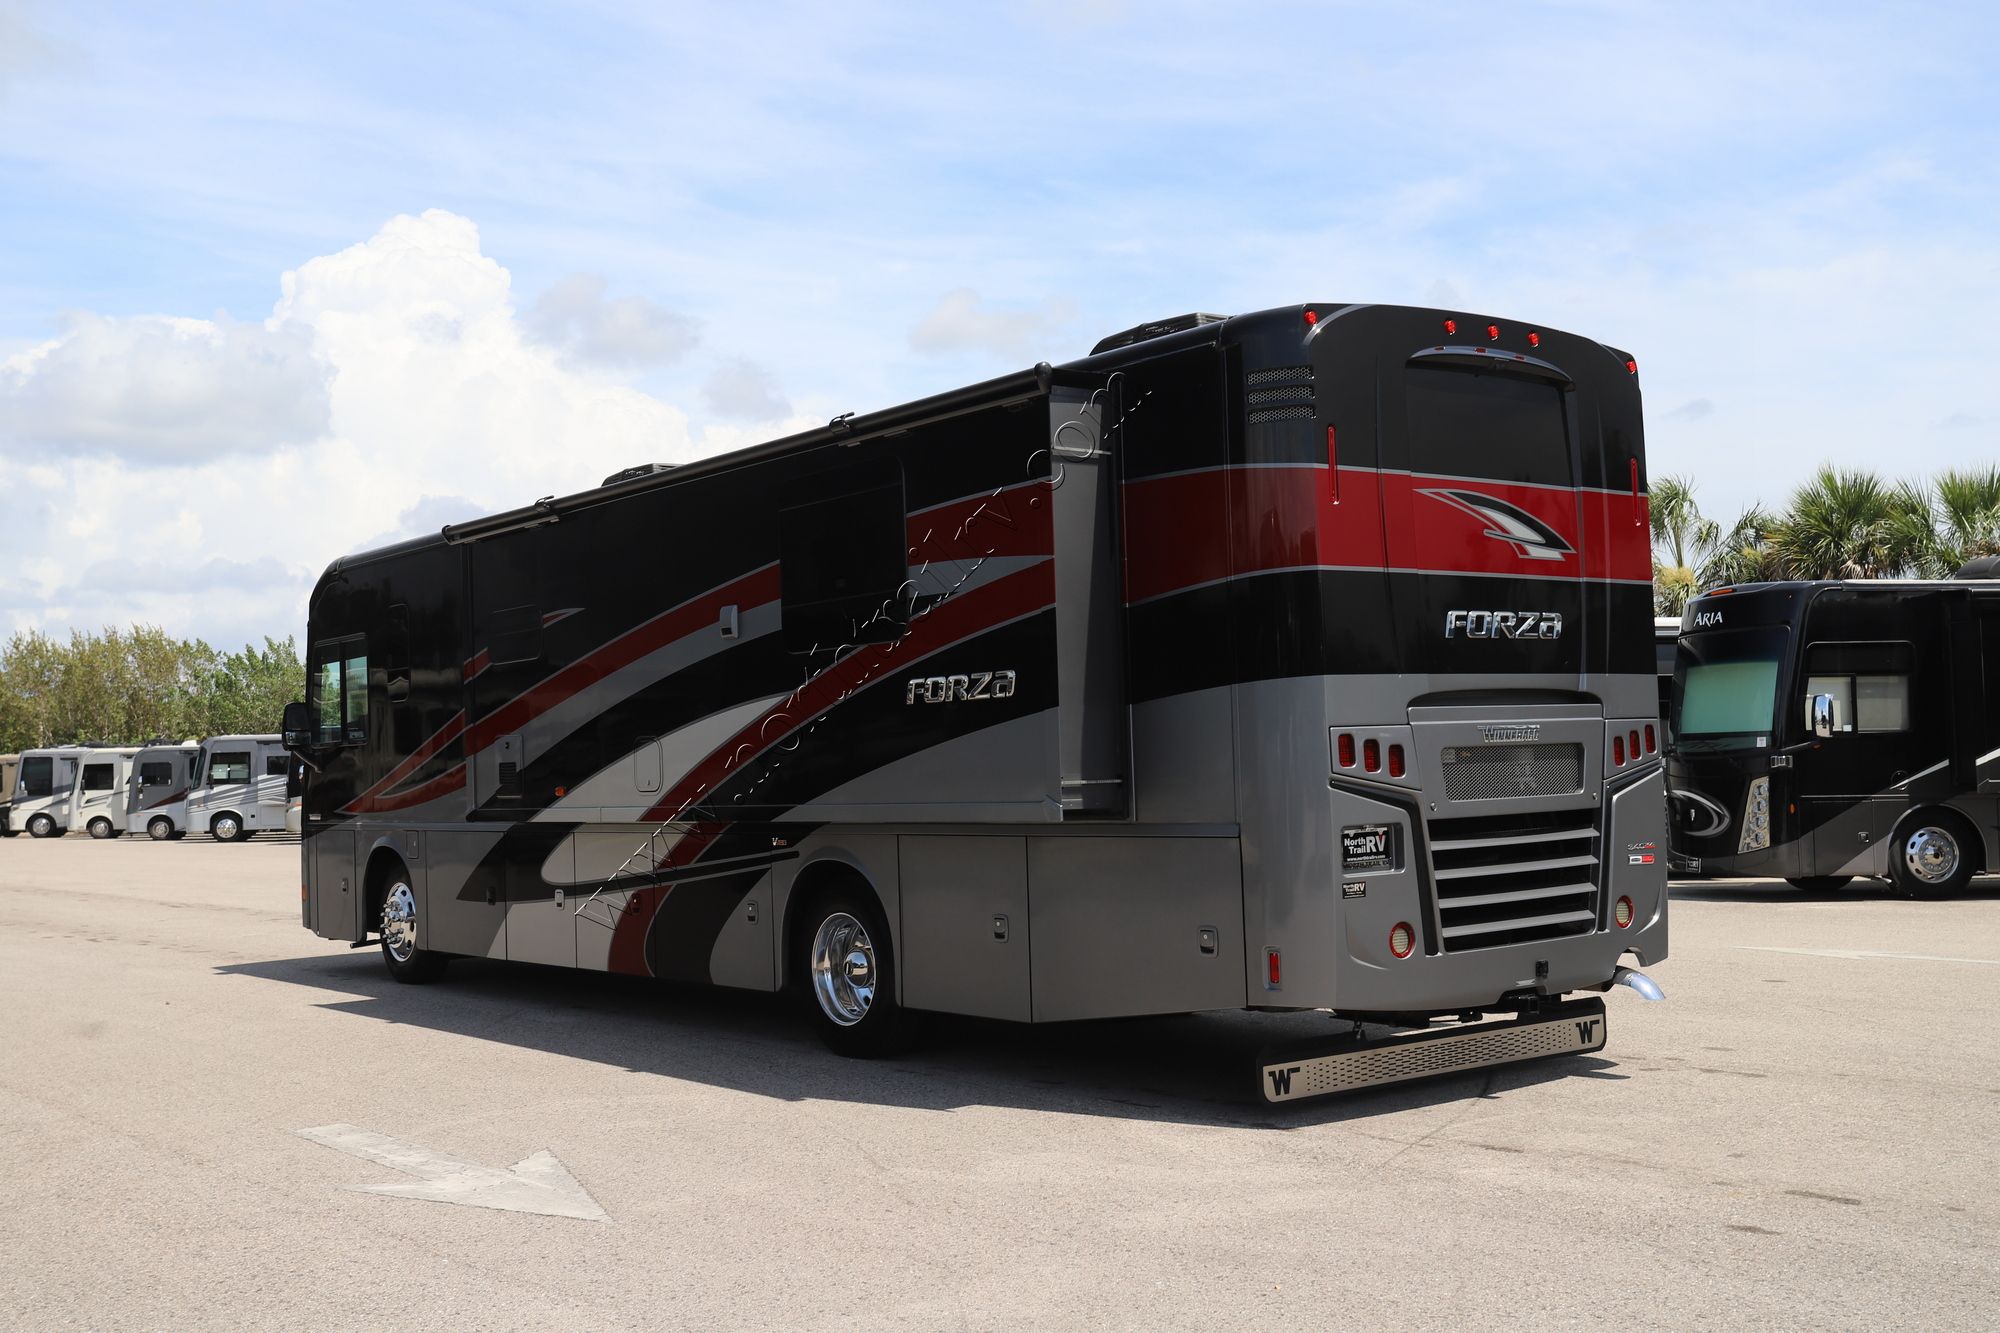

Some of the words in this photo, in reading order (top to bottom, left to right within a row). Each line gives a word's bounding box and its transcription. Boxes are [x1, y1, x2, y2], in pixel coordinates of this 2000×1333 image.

[1693, 611, 1723, 628] ARIA
[1344, 837, 1366, 846] North
[1366, 836, 1386, 853] RV
[1348, 845, 1366, 854] Trail
[1354, 883, 1365, 891] RV
